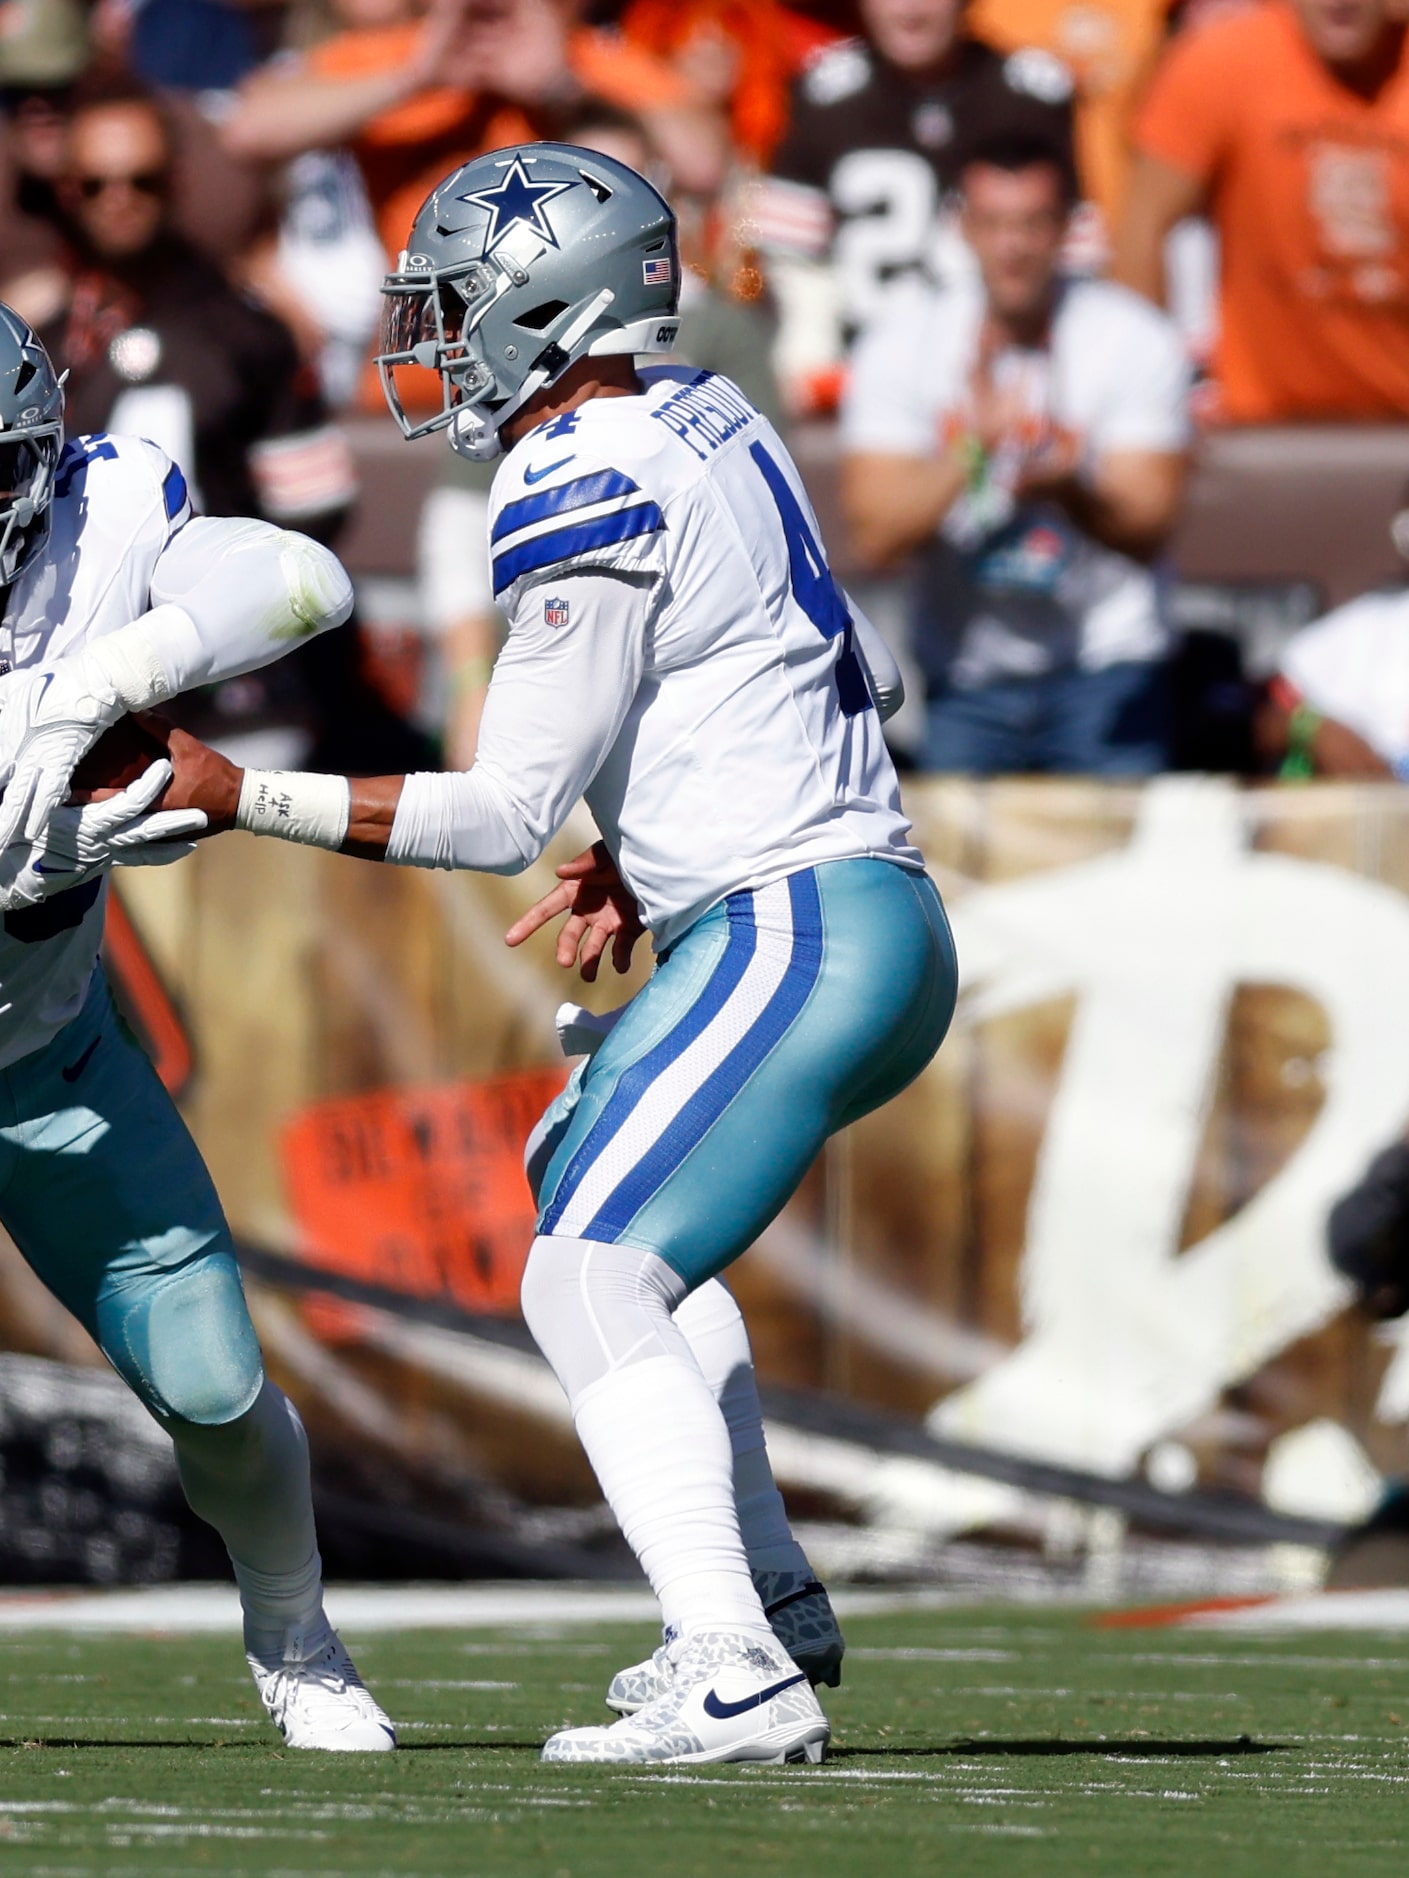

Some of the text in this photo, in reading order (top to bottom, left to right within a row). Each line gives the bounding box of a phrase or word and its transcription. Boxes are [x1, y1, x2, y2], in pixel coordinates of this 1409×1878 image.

[525, 408, 582, 441] 4
[749, 439, 875, 719] 4
[547, 610, 568, 625] NFL
